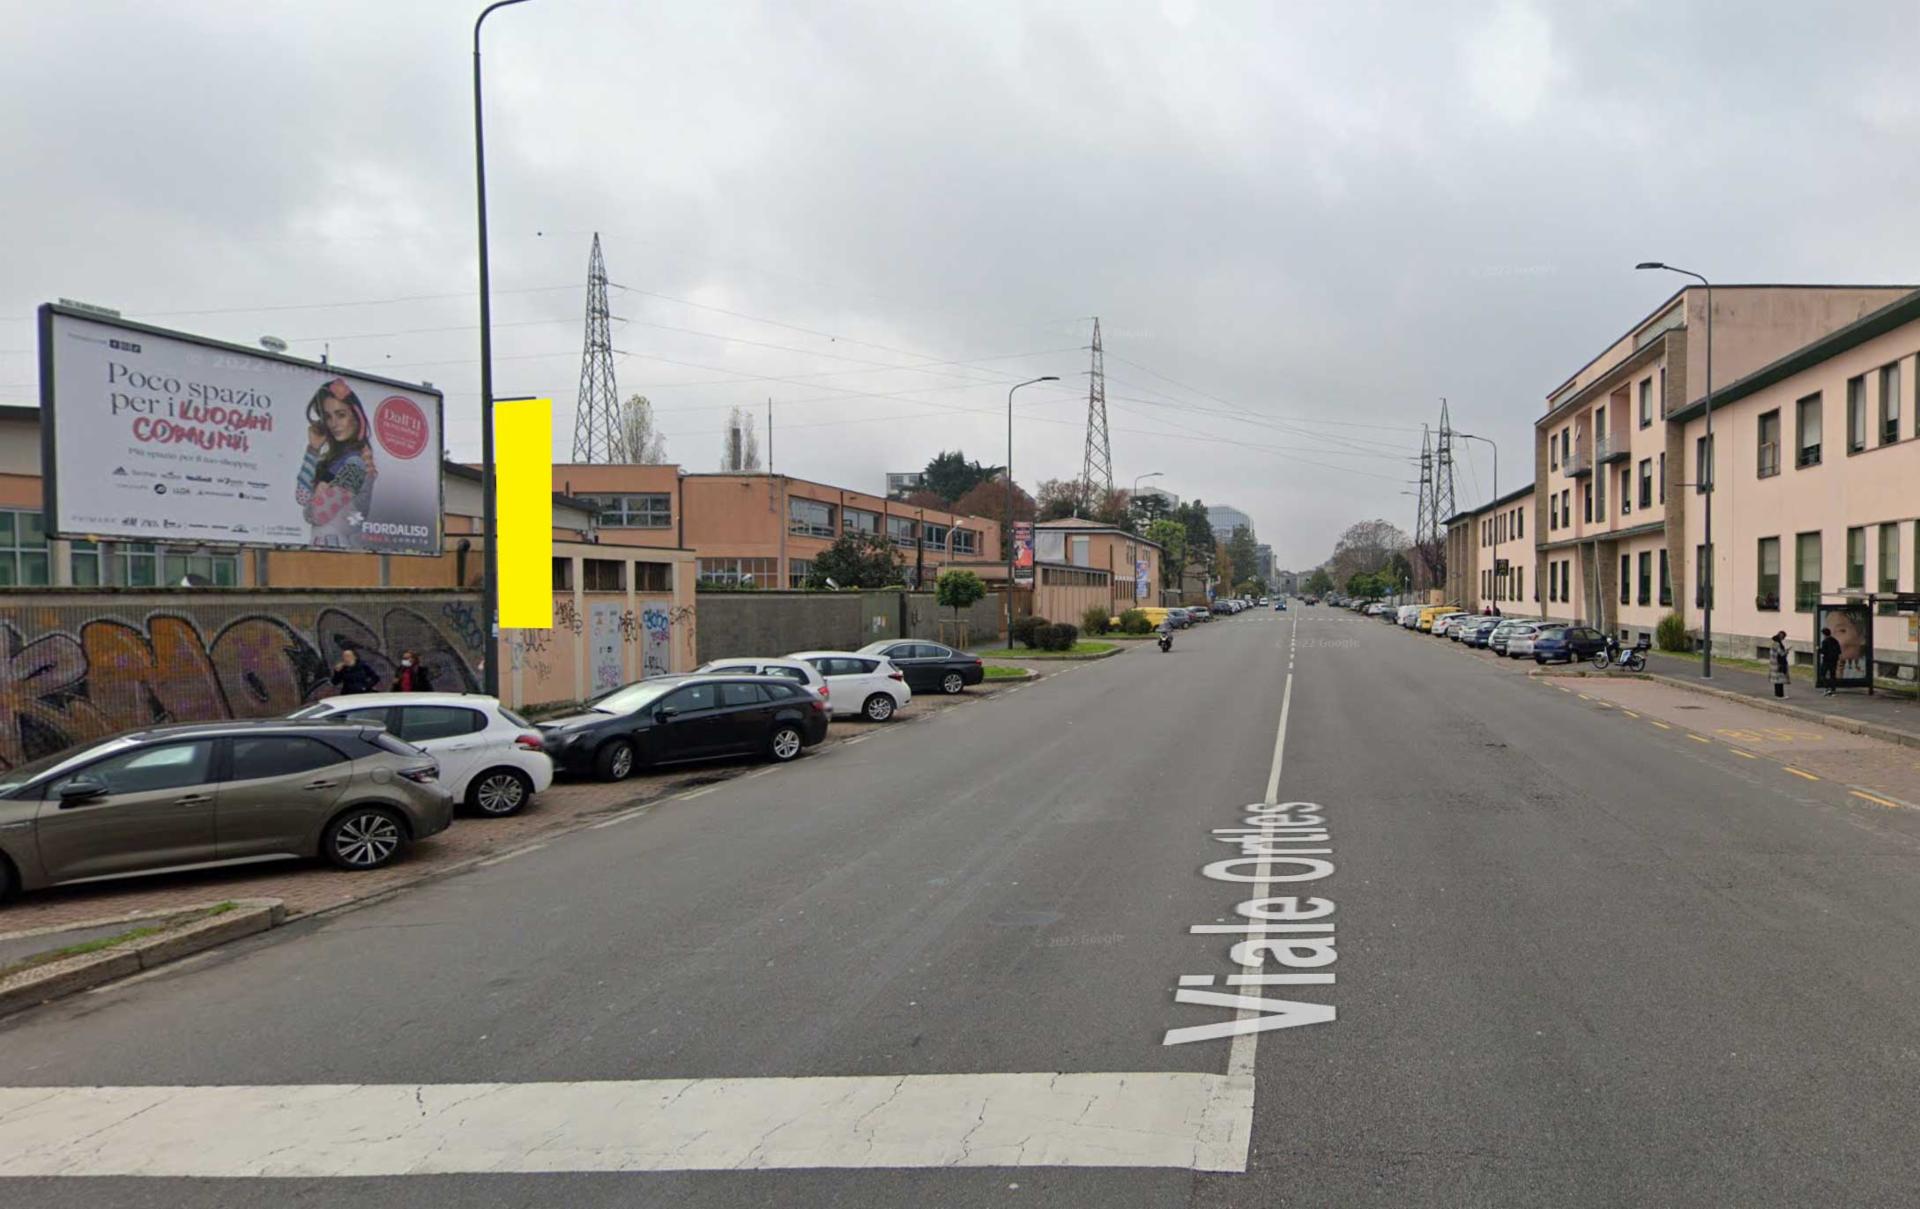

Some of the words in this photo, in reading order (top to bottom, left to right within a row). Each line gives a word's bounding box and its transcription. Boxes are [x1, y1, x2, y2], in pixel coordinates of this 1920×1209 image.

[109, 362, 181, 394] Poco
[188, 381, 272, 409] spazio
[111, 392, 160, 415] per
[168, 397, 174, 417] i
[361, 521, 429, 538] FIORDALISO
